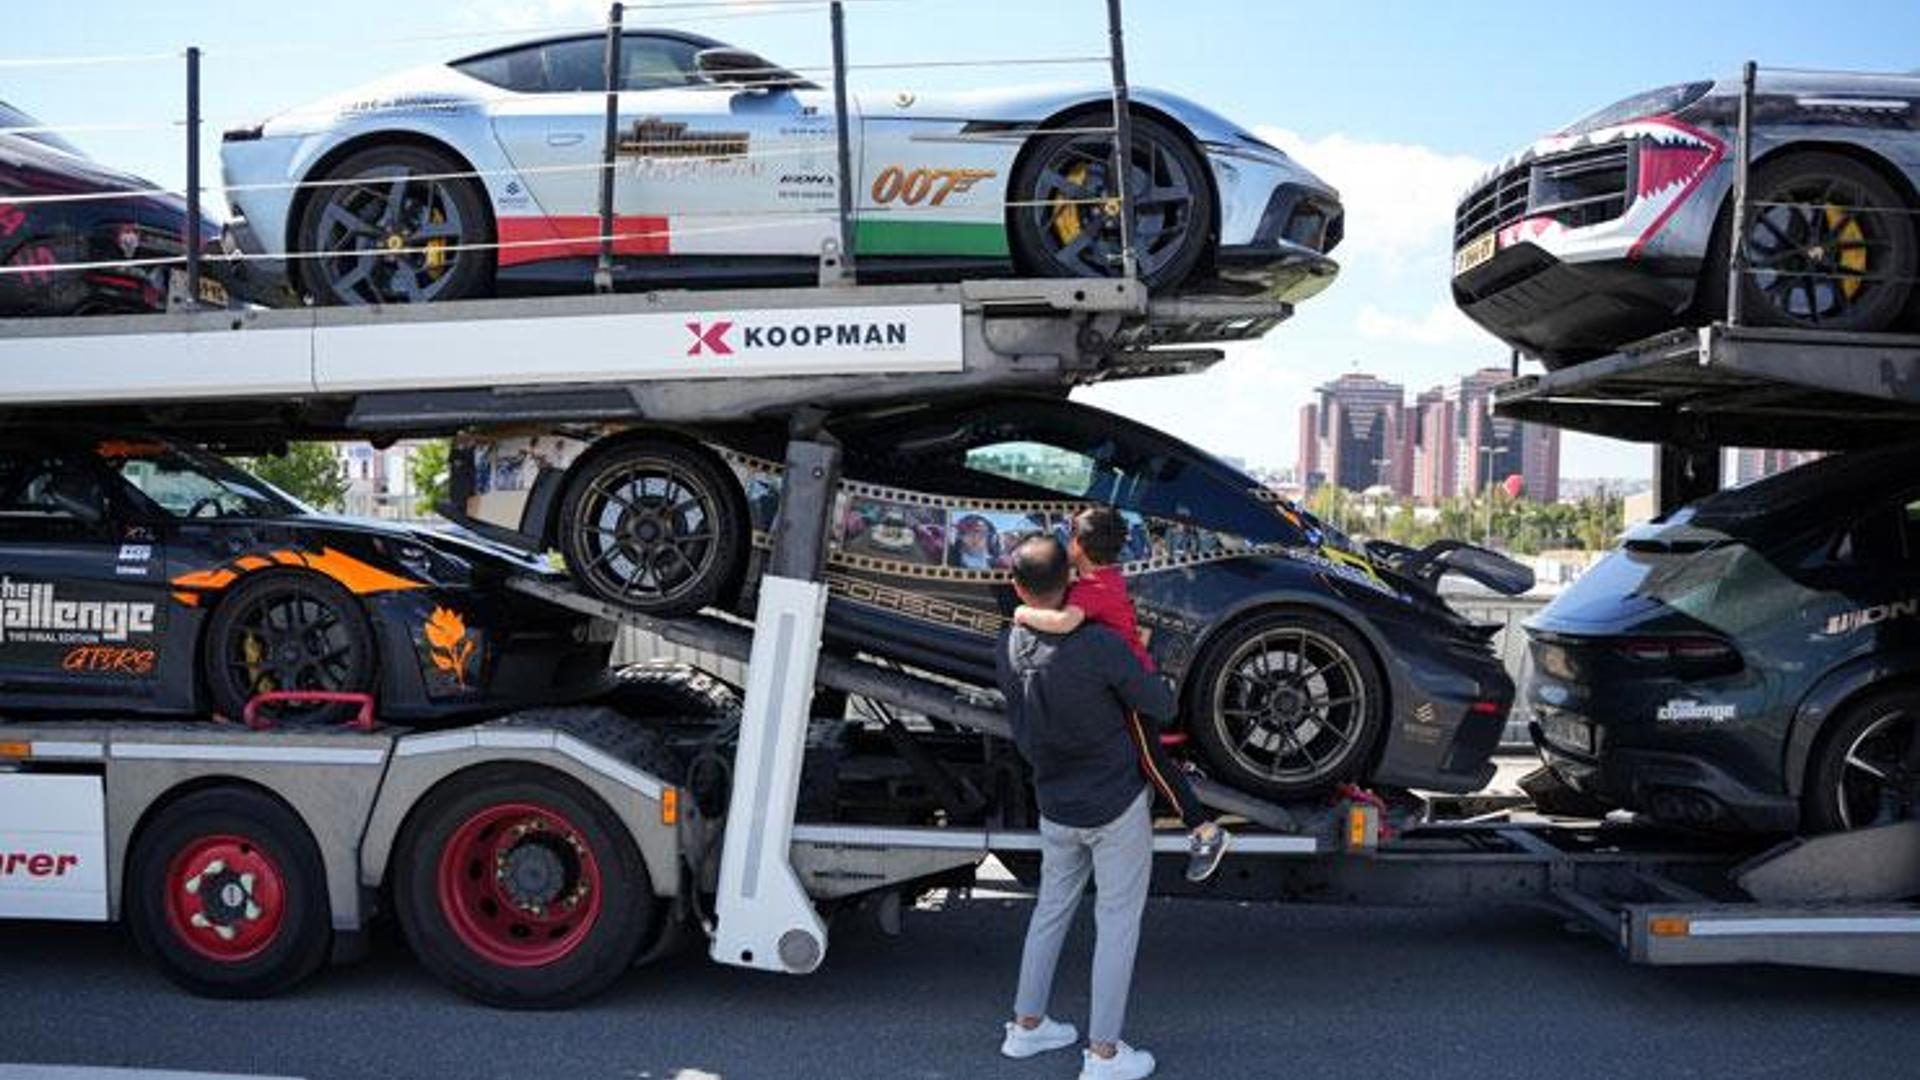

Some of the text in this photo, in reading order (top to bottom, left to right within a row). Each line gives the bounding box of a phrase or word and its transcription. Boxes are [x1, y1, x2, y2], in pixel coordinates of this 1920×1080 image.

[871, 165, 997, 206] 007
[744, 323, 906, 347] KOOPMAN
[0, 576, 30, 598] he
[828, 577, 1003, 634] PORSCHE
